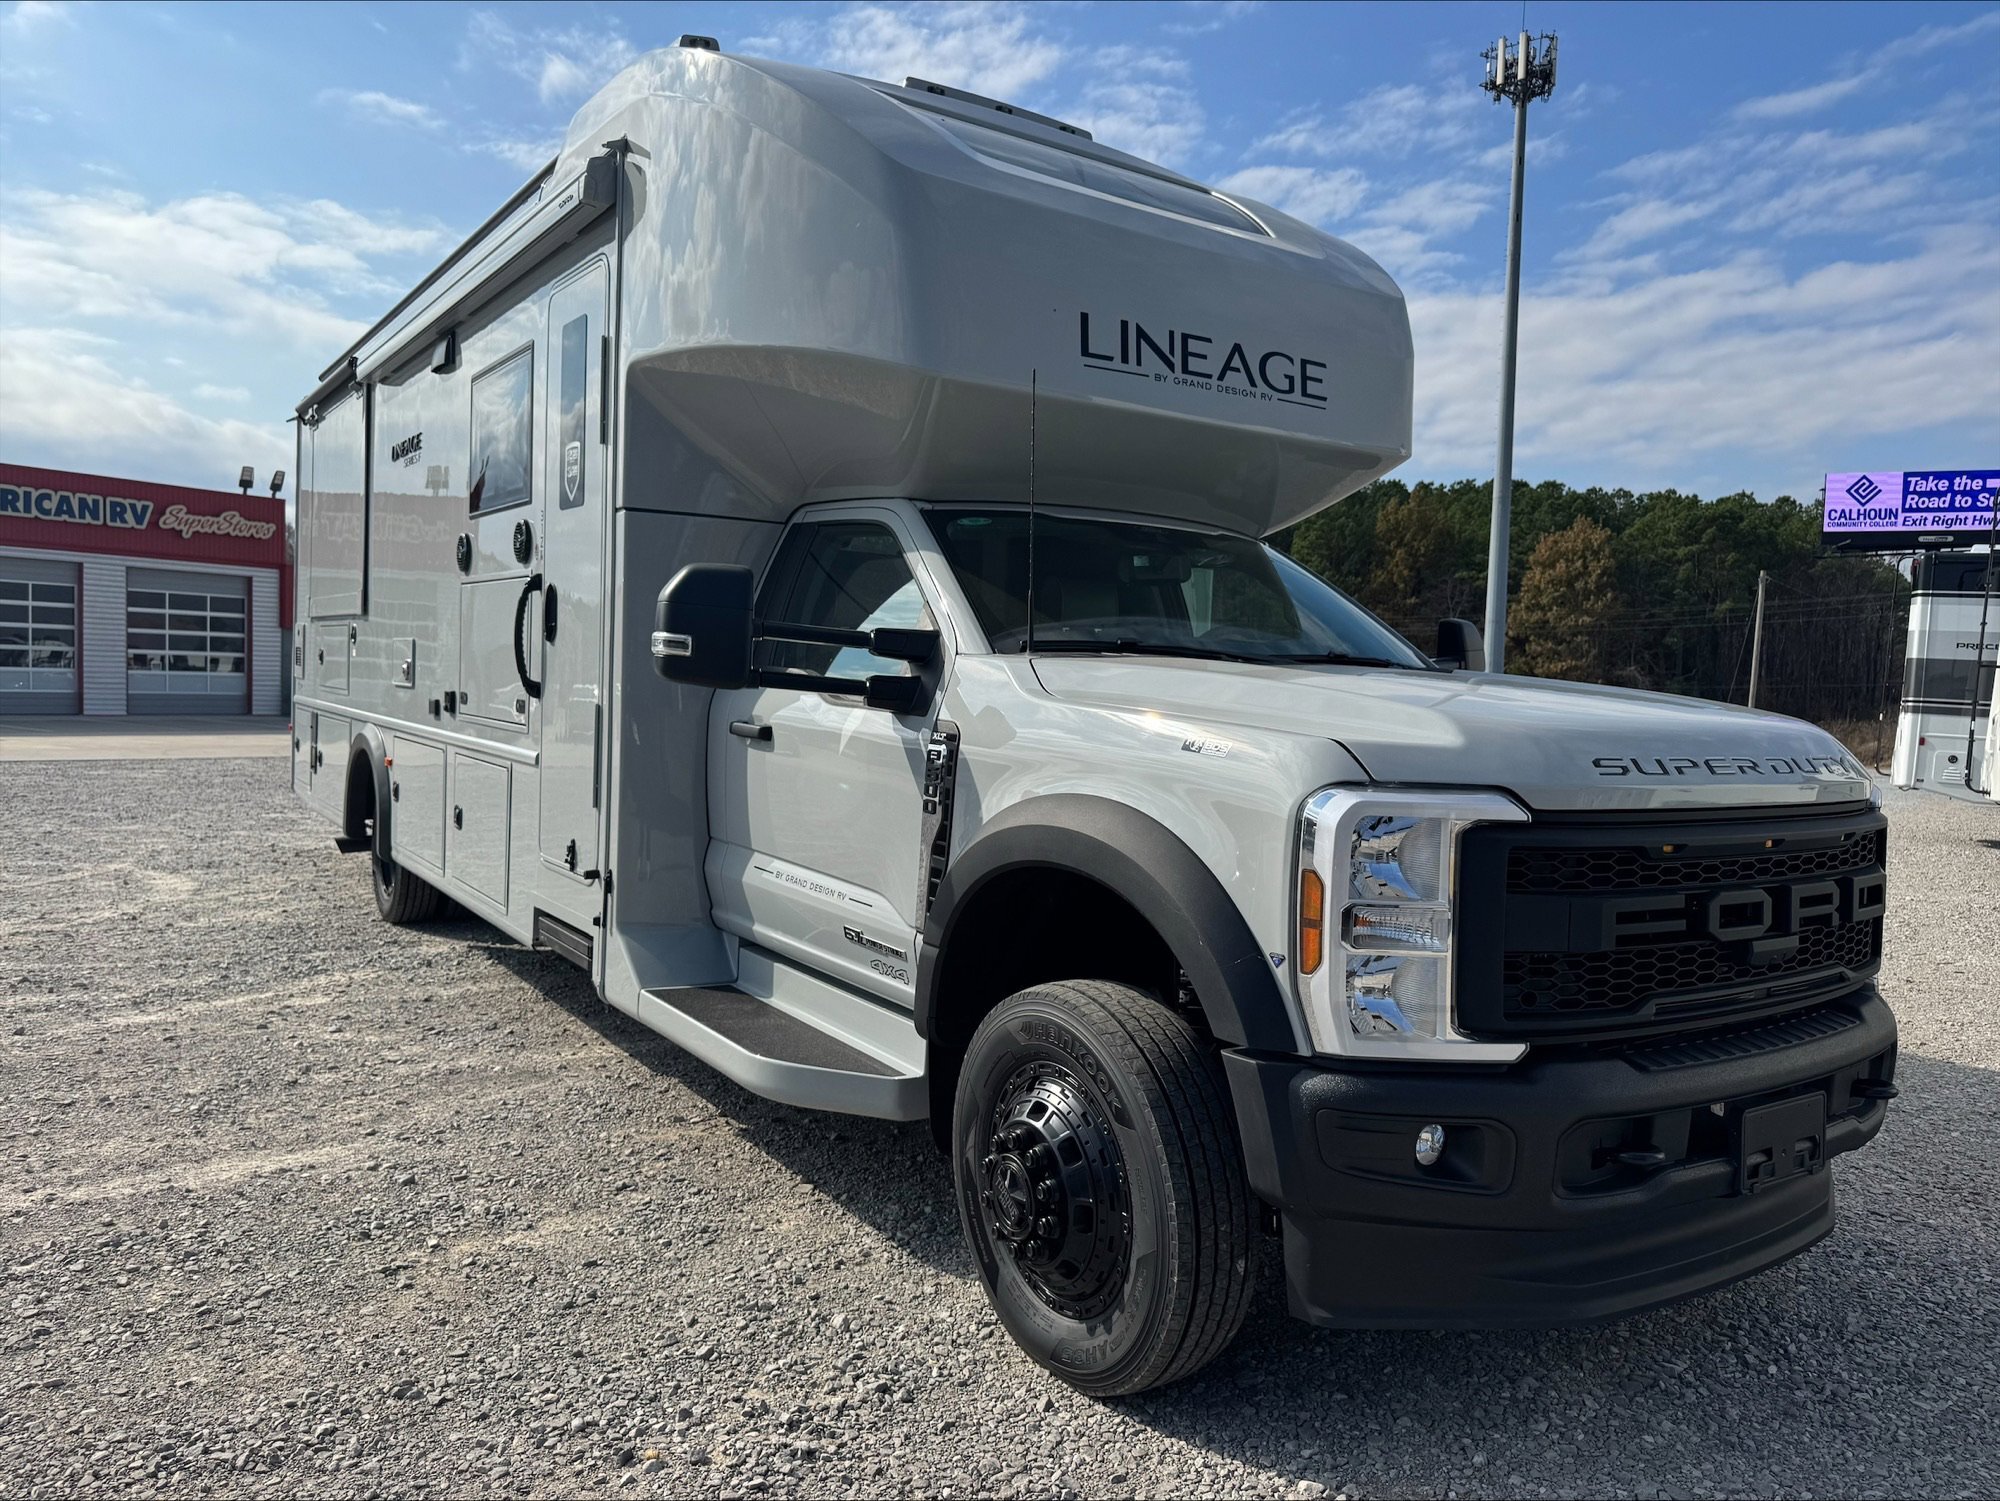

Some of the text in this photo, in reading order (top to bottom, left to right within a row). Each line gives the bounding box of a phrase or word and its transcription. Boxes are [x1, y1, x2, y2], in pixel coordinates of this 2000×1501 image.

[1080, 311, 1328, 402] LINEAGE
[1153, 372, 1273, 402] BY GRAND DESIGN RV
[1907, 475, 1983, 492] Take the
[1905, 494, 1950, 508] Road
[1955, 494, 1972, 508] to
[107, 500, 153, 528] RV
[159, 504, 276, 540] SuperStores
[1828, 508, 1899, 521] CALHOUN
[1902, 515, 1927, 527] Exit
[1931, 515, 1968, 528] Right
[932, 732, 947, 741] XLT
[1592, 756, 1851, 776] SUPER DUTY
[775, 870, 847, 901] BY GRAND DESIGN RV
[1600, 874, 1886, 951] FORD
